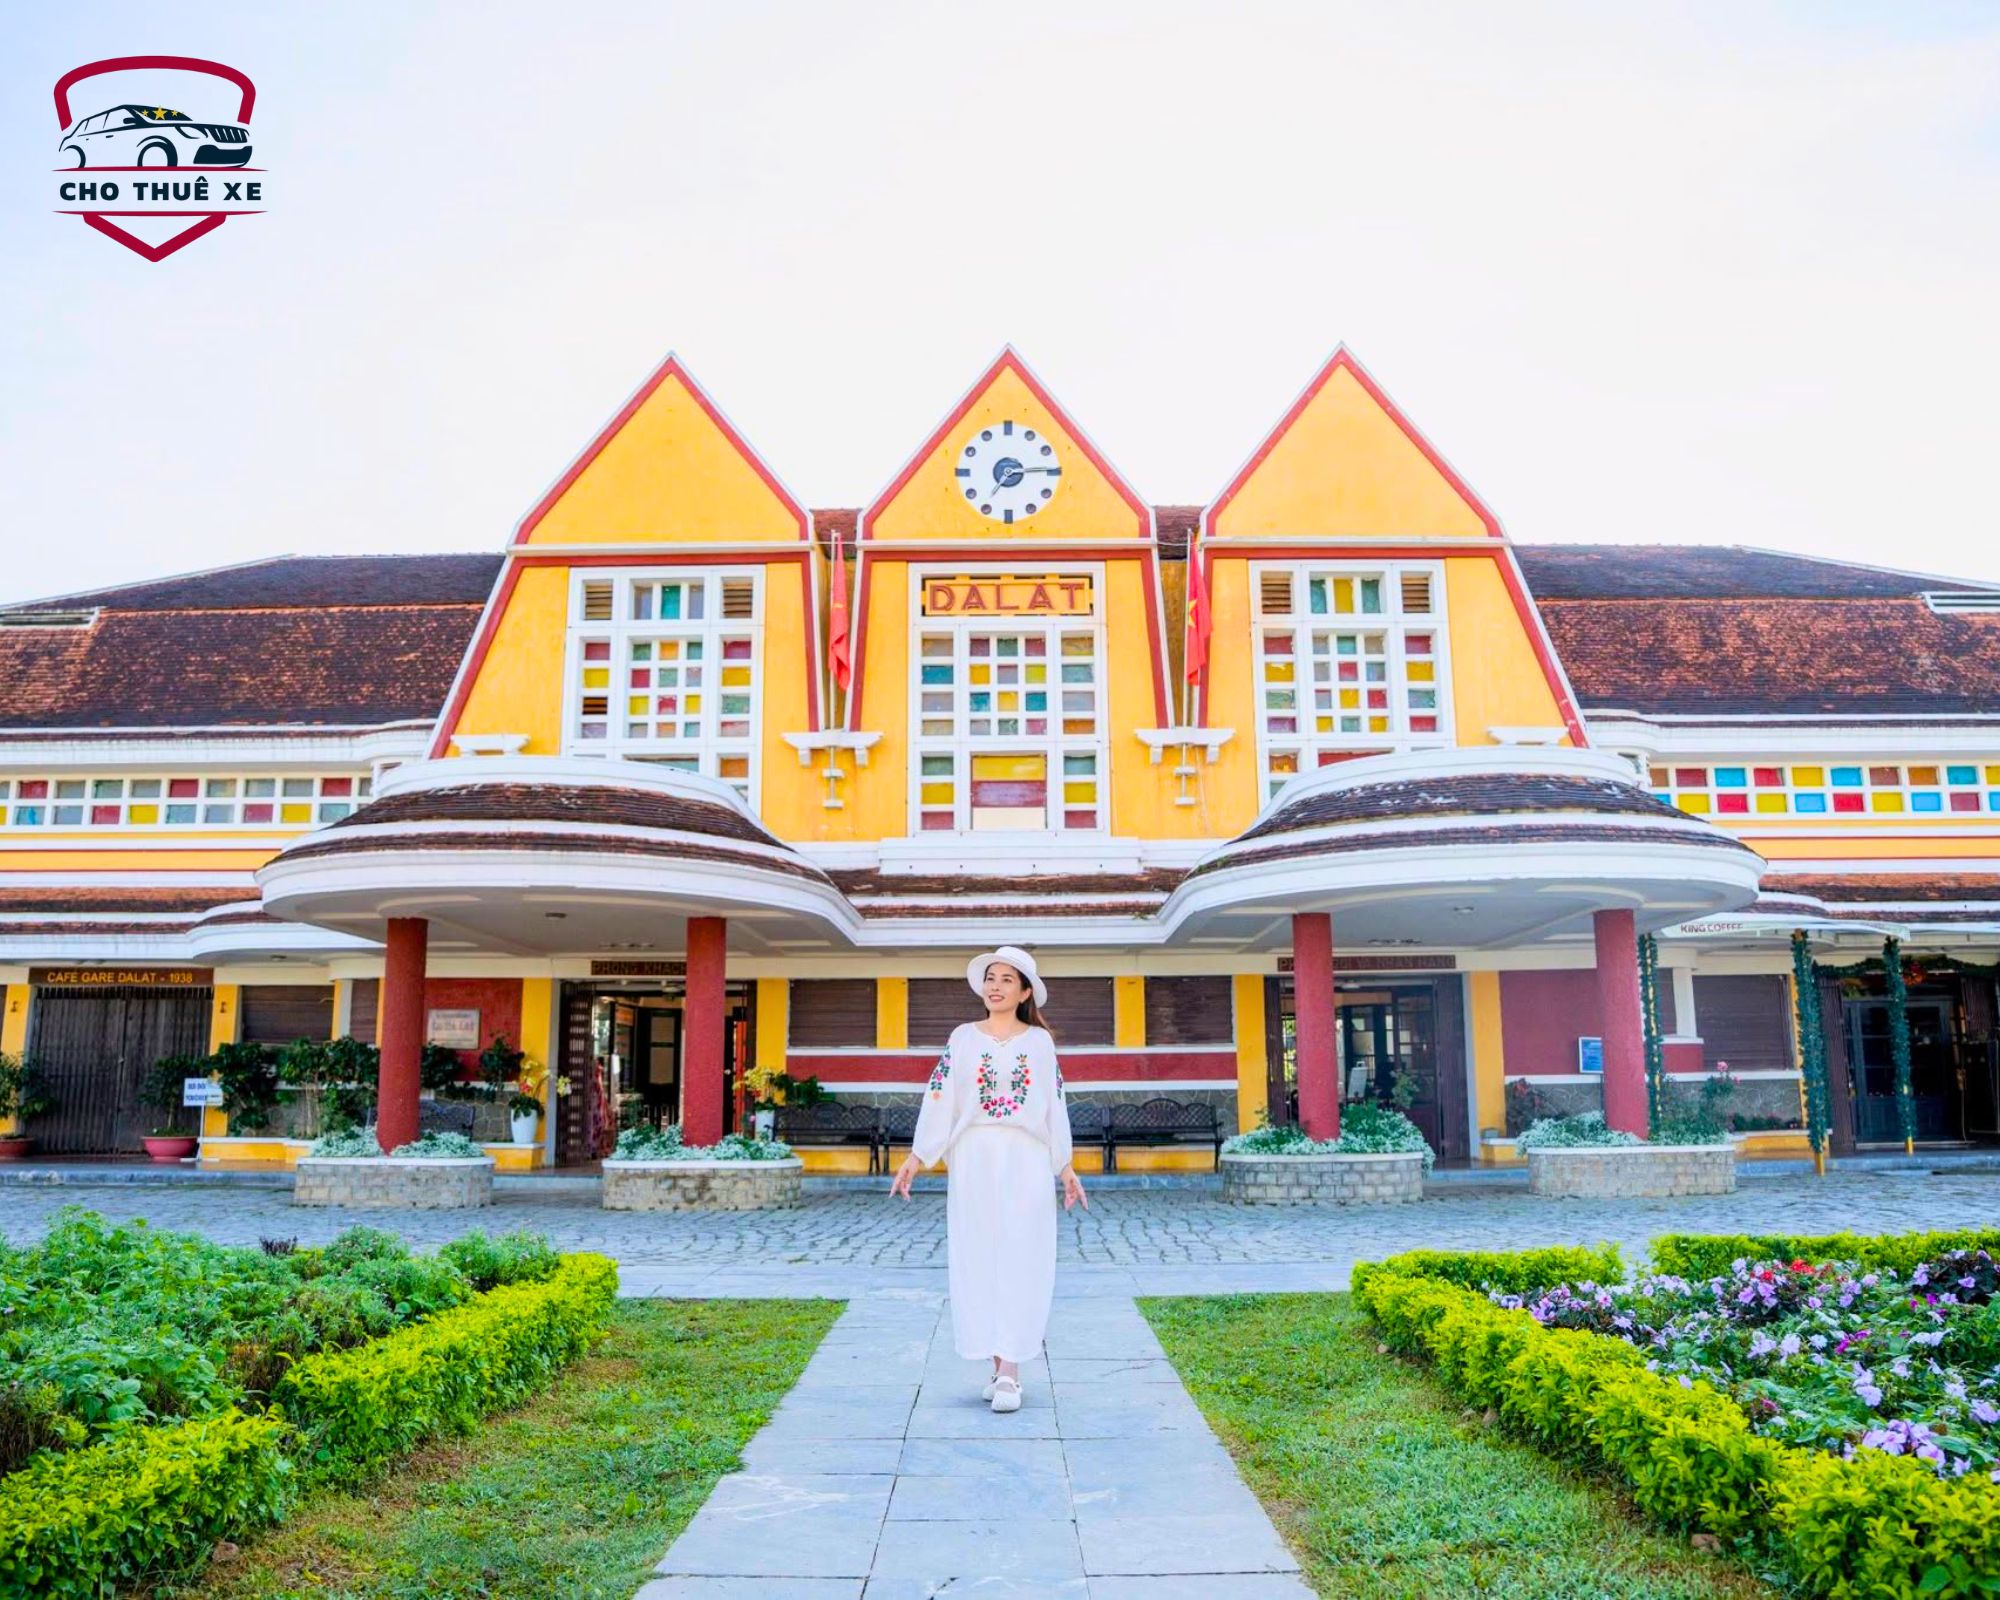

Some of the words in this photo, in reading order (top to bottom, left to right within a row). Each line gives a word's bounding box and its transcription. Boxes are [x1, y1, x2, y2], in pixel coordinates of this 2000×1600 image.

[929, 583, 1085, 612] DALAT
[1680, 924, 1706, 933] KING
[47, 972, 78, 983] CAFE
[81, 972, 115, 983] GARE
[117, 972, 156, 983] DALAT
[169, 972, 193, 984] 1938
